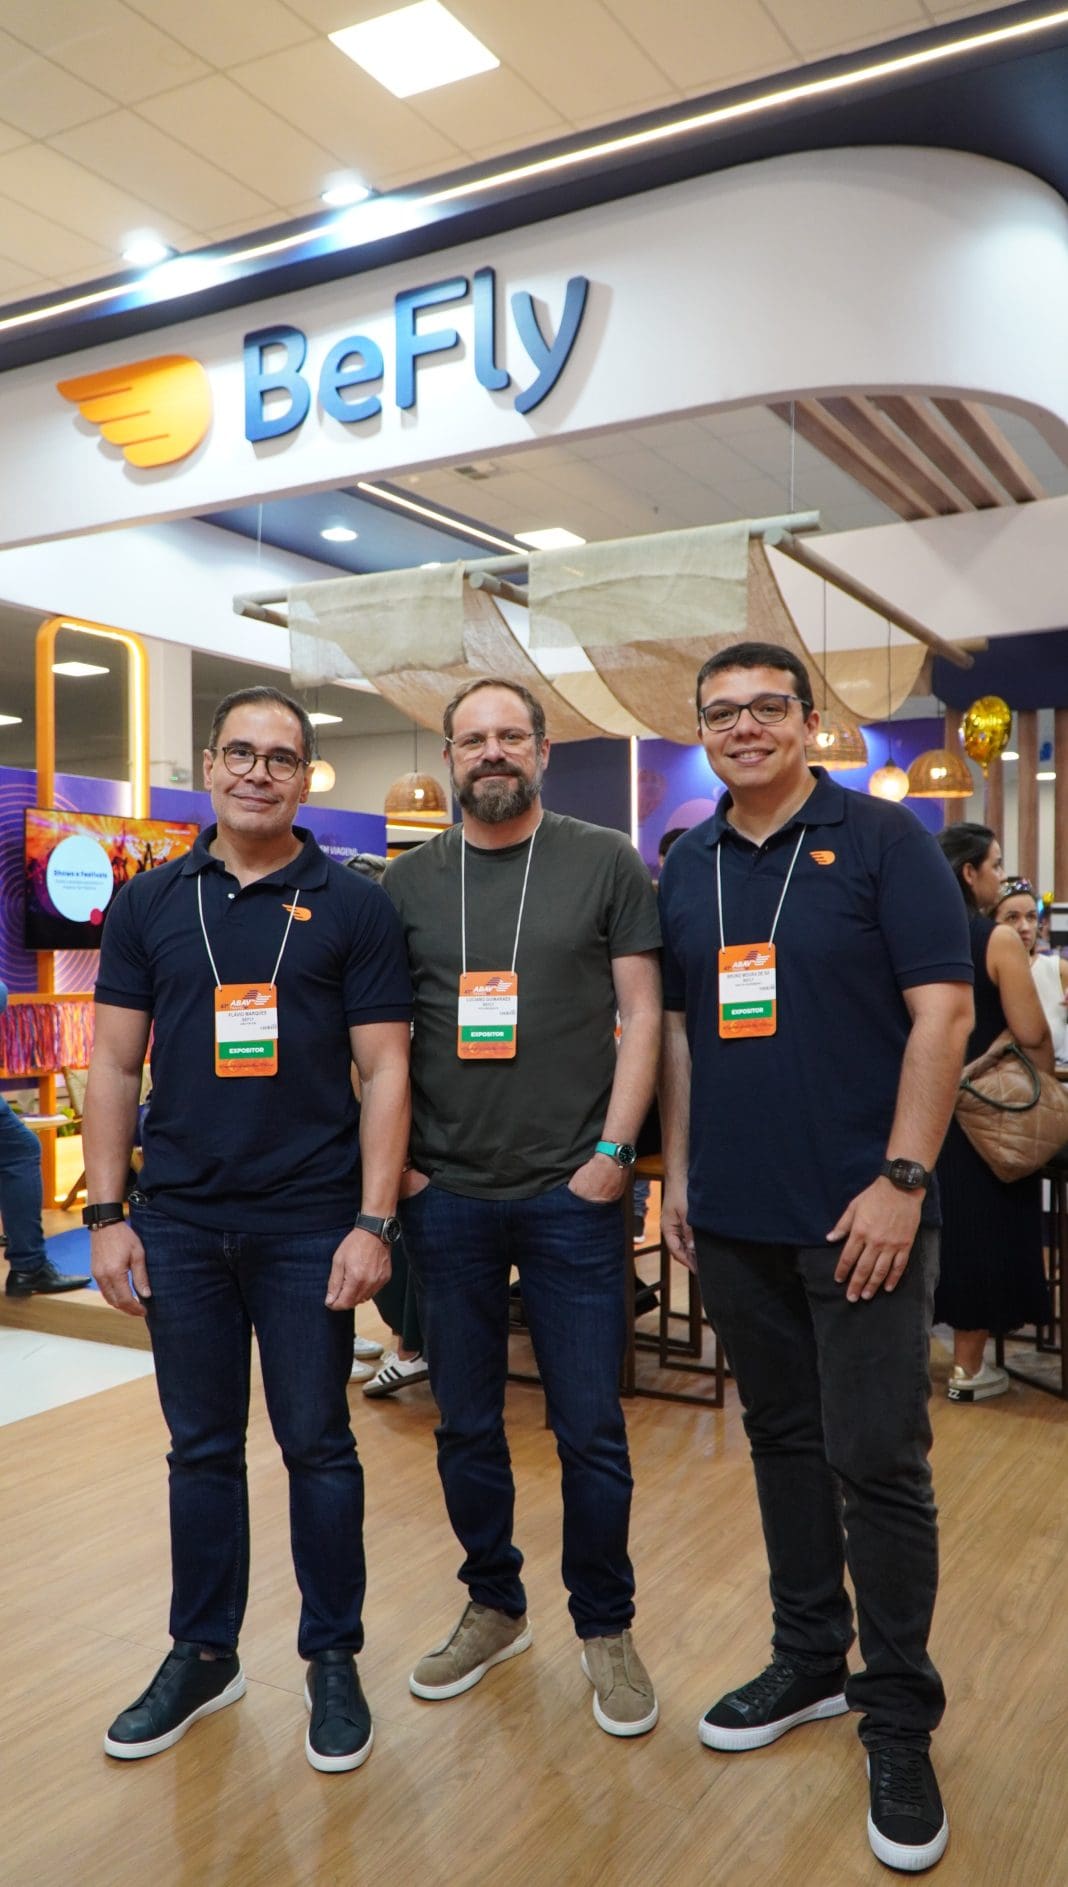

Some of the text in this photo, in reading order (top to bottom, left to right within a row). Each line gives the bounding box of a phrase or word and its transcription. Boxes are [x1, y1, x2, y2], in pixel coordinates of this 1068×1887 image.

[242, 265, 590, 444] BeFly
[230, 999, 252, 1007] ABAV
[731, 1007, 764, 1015] EXPOSITOR
